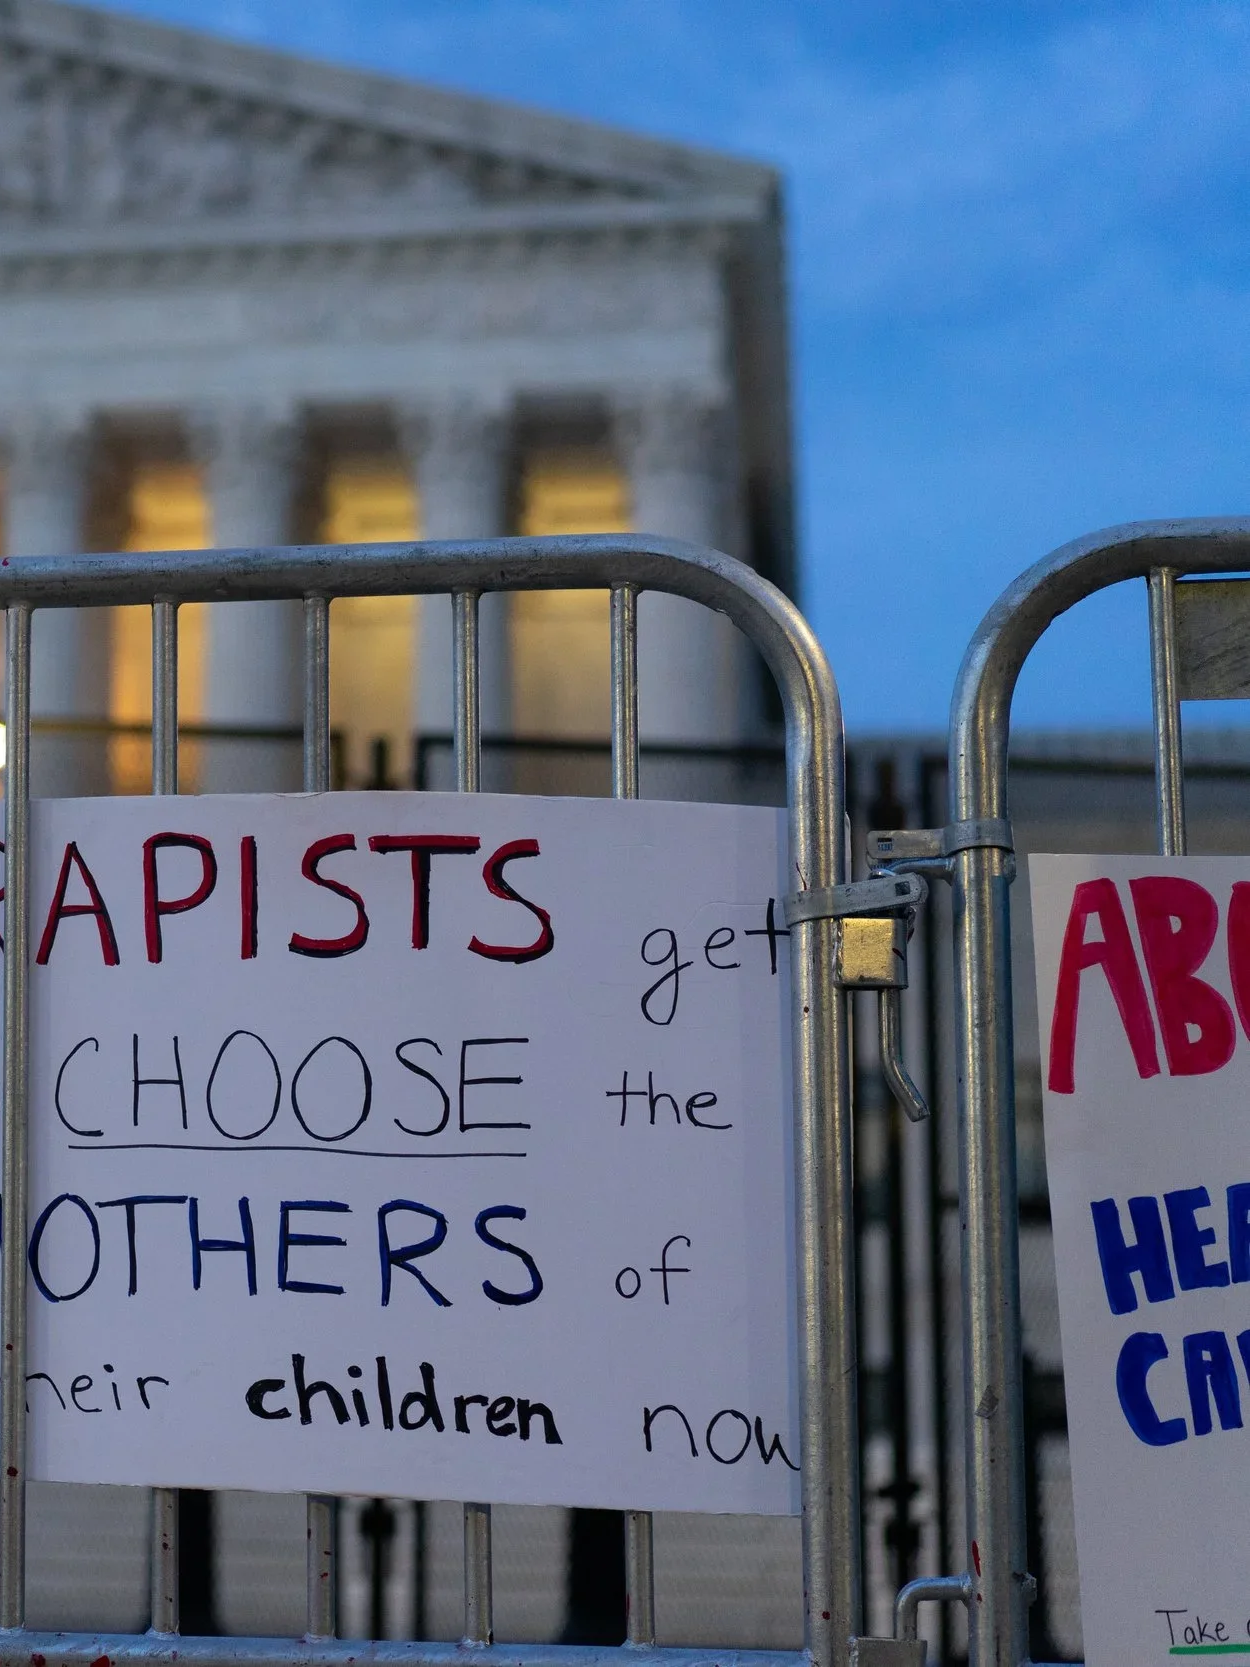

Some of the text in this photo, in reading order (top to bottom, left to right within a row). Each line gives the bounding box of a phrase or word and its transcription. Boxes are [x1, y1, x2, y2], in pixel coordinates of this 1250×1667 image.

[641, 897, 791, 1026] get
[55, 1030, 531, 1142] CHOOSE
[606, 1071, 732, 1130] the
[616, 1236, 692, 1305] of
[245, 1354, 563, 1445] children
[1116, 1328, 1250, 1446] CA
[1155, 1609, 1229, 1645] Take
